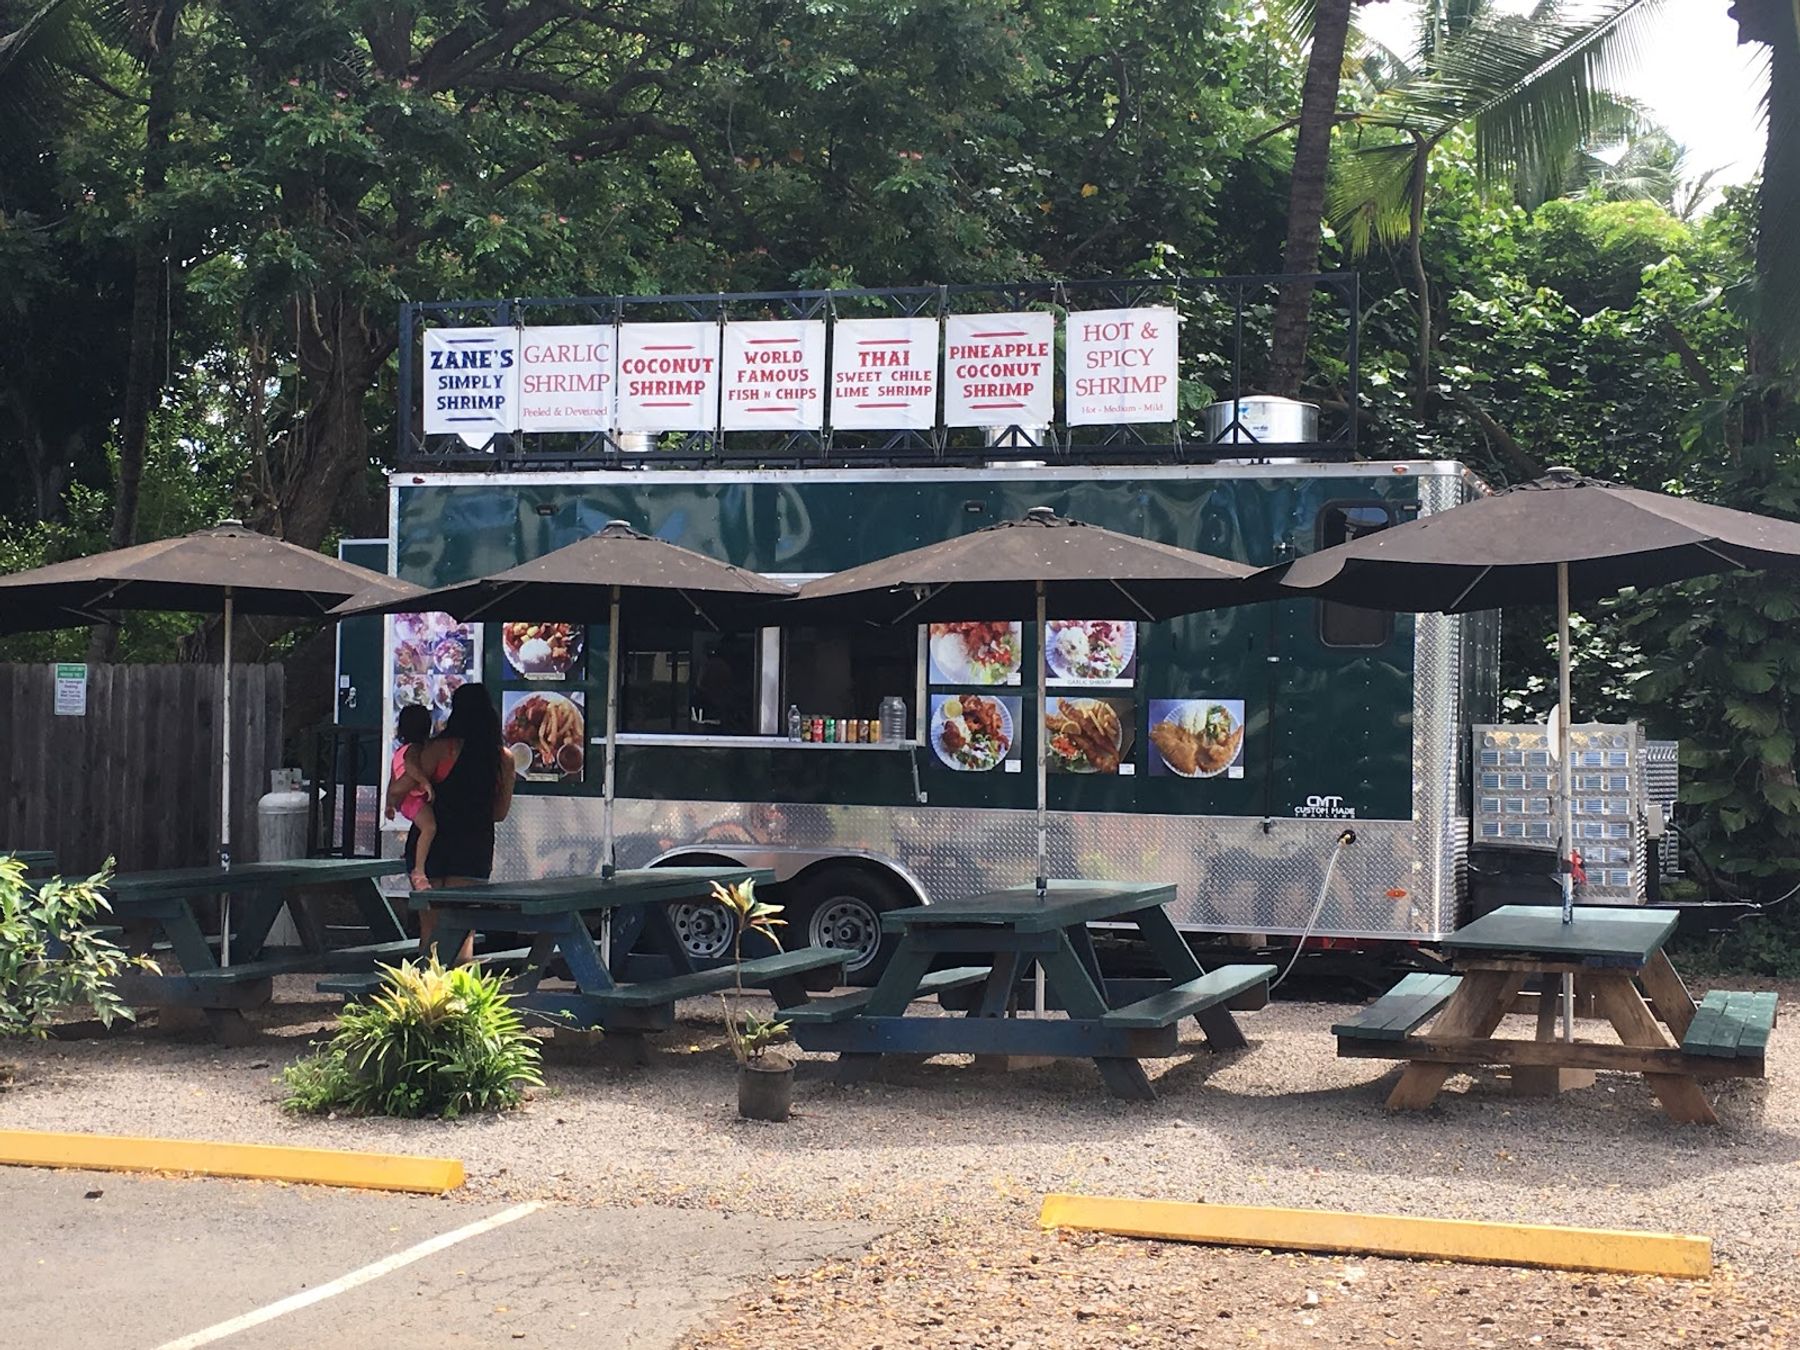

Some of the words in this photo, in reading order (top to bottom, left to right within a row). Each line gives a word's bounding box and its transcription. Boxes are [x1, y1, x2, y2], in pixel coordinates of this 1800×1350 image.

[1083, 322, 1134, 343] HOT
[1141, 322, 1159, 339] &
[524, 344, 610, 364] GARLIC
[744, 350, 803, 365] WORLD
[858, 350, 910, 367] THAI
[949, 342, 1049, 360] PINEAPPLE
[1086, 347, 1154, 369] SPICY
[430, 349, 514, 371] ZANE'S
[622, 358, 715, 375] COCONUT
[737, 368, 809, 383] FAMOUS
[836, 371, 883, 383] SWEET
[890, 370, 932, 382] CHILE
[955, 362, 1042, 378] COCONUT
[438, 375, 504, 390] SIMPLY
[524, 373, 611, 393] SHRIMP
[629, 379, 706, 396] SHRIMP
[963, 382, 1035, 398] SHRIMP
[1076, 375, 1168, 396] SHRIMP
[728, 388, 760, 401] FISH
[775, 387, 817, 400] CHIPS
[836, 386, 869, 398] LIME
[878, 385, 933, 397] SHRIMP
[436, 395, 506, 411] SHRIMP
[1081, 406, 1096, 414] Hot
[1103, 404, 1137, 413] Medium
[523, 406, 551, 417] Peeled
[553, 406, 562, 417] &
[564, 406, 608, 417] Deveined
[1294, 806, 1328, 814] CUSTOM
[1331, 807, 1355, 815] MADE
